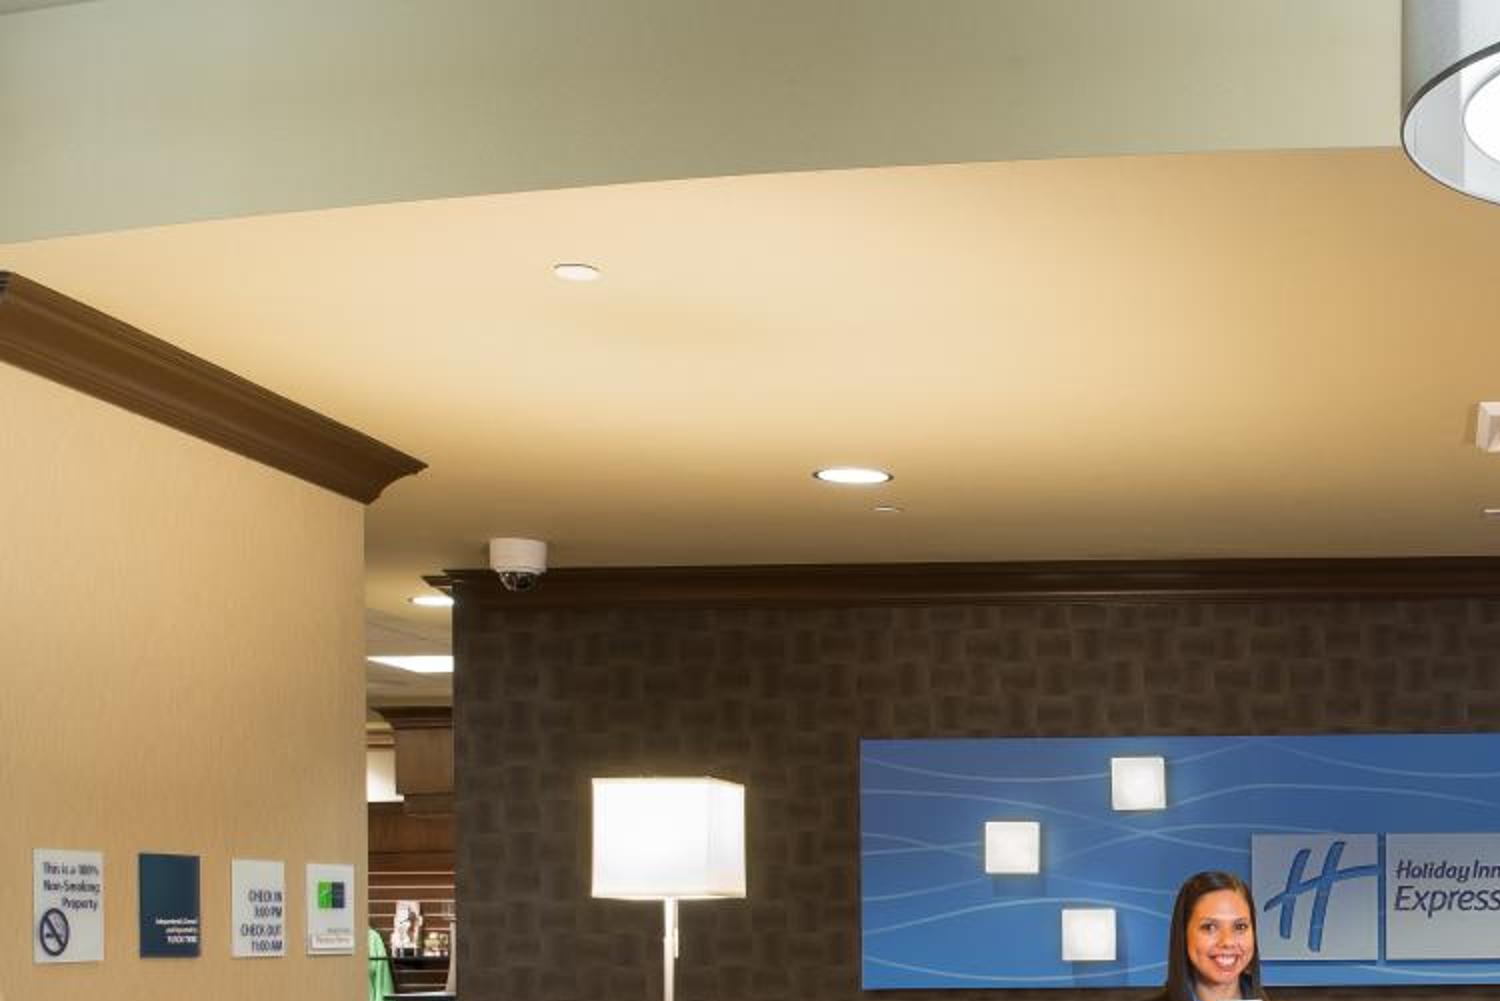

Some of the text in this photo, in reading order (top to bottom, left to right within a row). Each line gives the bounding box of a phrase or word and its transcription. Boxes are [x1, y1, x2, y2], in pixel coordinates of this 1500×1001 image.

[43, 862, 60, 875] This
[1395, 859, 1470, 884] Holiday
[43, 879, 101, 896] Non-Smoking
[248, 889, 273, 903] CHECK
[62, 897, 98, 912] Property
[240, 922, 266, 937] CHECK
